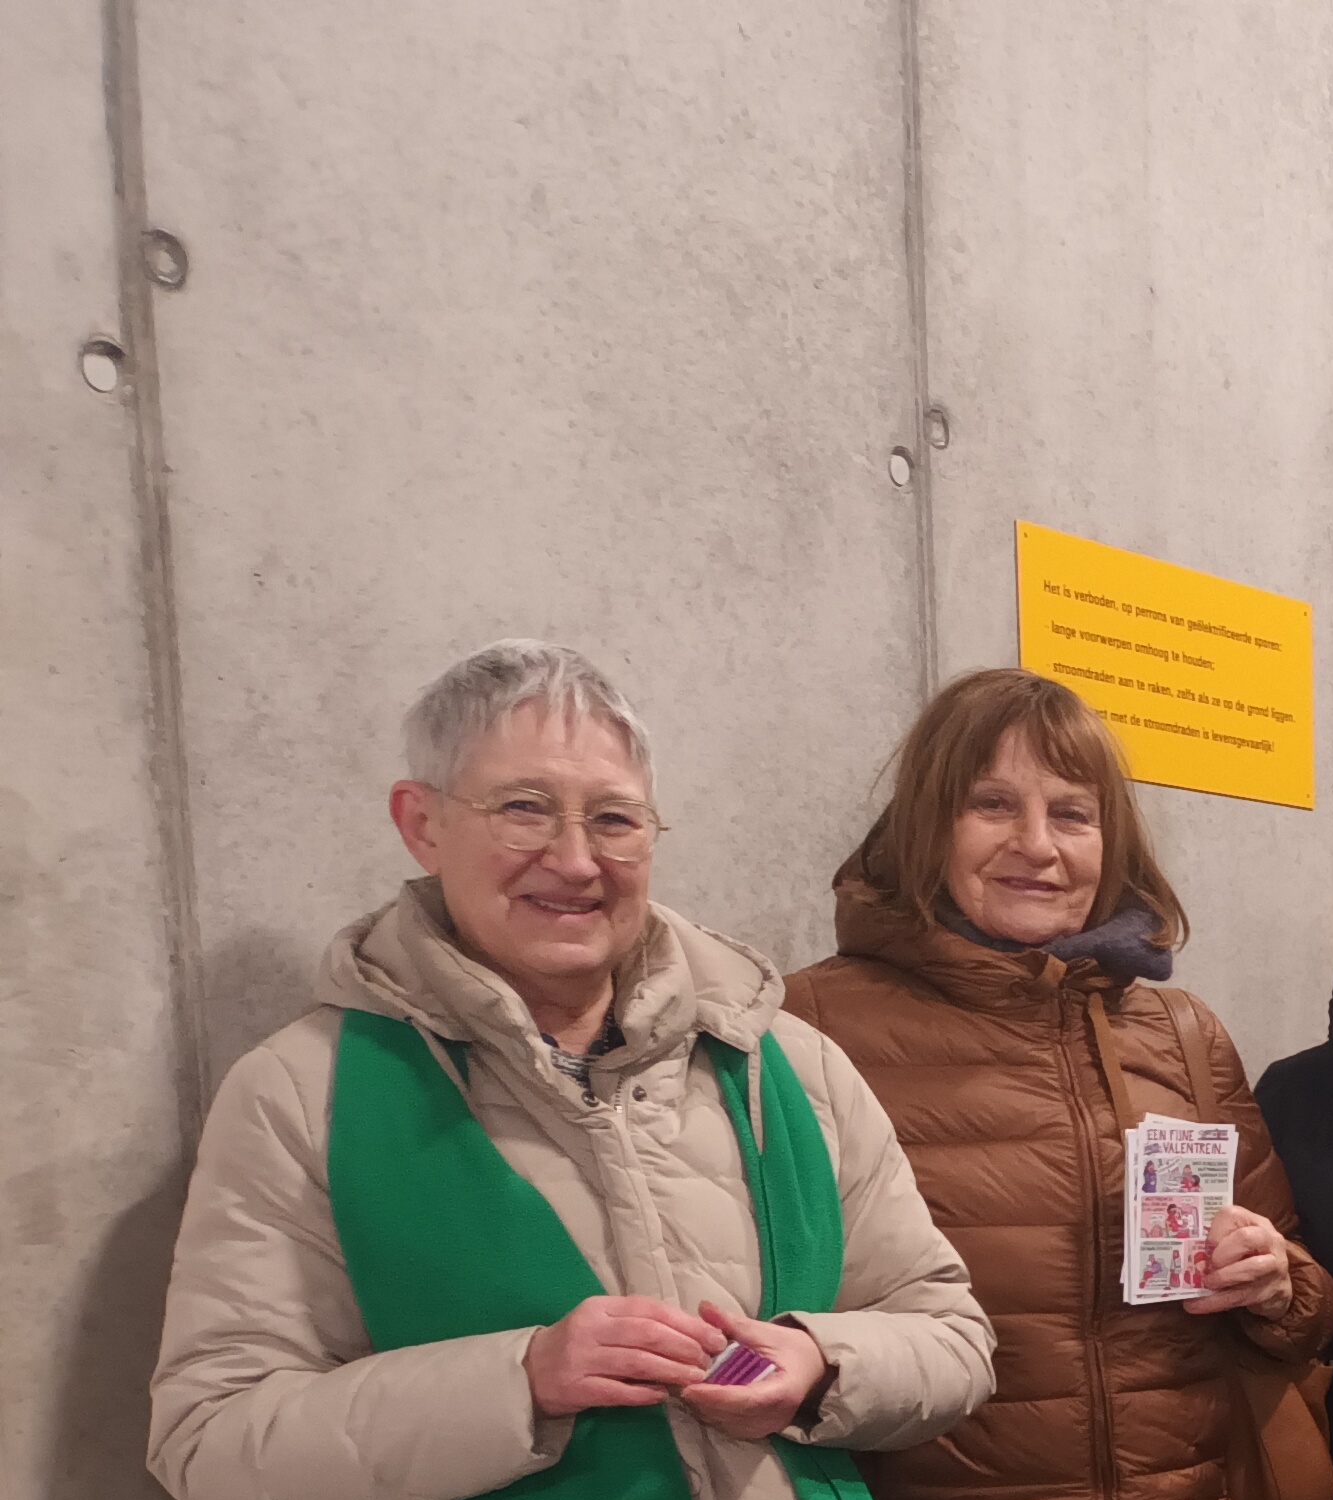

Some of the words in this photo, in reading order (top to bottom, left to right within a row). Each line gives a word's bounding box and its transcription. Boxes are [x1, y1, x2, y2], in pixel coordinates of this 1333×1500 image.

[1043, 580, 1061, 596] Het
[1063, 584, 1072, 599] is
[1074, 590, 1119, 611] verboden,
[1122, 602, 1133, 616] op
[1135, 606, 1167, 623] perrons
[1170, 614, 1185, 627] van
[1051, 620, 1077, 640] lange
[1079, 630, 1132, 650] voorwerpen
[1135, 642, 1169, 663] omhoog
[1172, 650, 1180, 662] te
[1053, 662, 1116, 685] stroomdraden
[1118, 676, 1134, 689] aan
[1137, 679, 1146, 691] te
[1176, 687, 1196, 702] zelfs
[1198, 691, 1210, 705] als
[1211, 697, 1221, 708] ze
[1223, 699, 1233, 712] op
[1235, 699, 1245, 713] de
[1247, 704, 1269, 717] grond
[1110, 711, 1128, 725] met
[1130, 713, 1141, 727] de
[1143, 718, 1201, 739] stroomdraden
[1202, 727, 1210, 740] is
[1147, 1129, 1167, 1141] EEN
